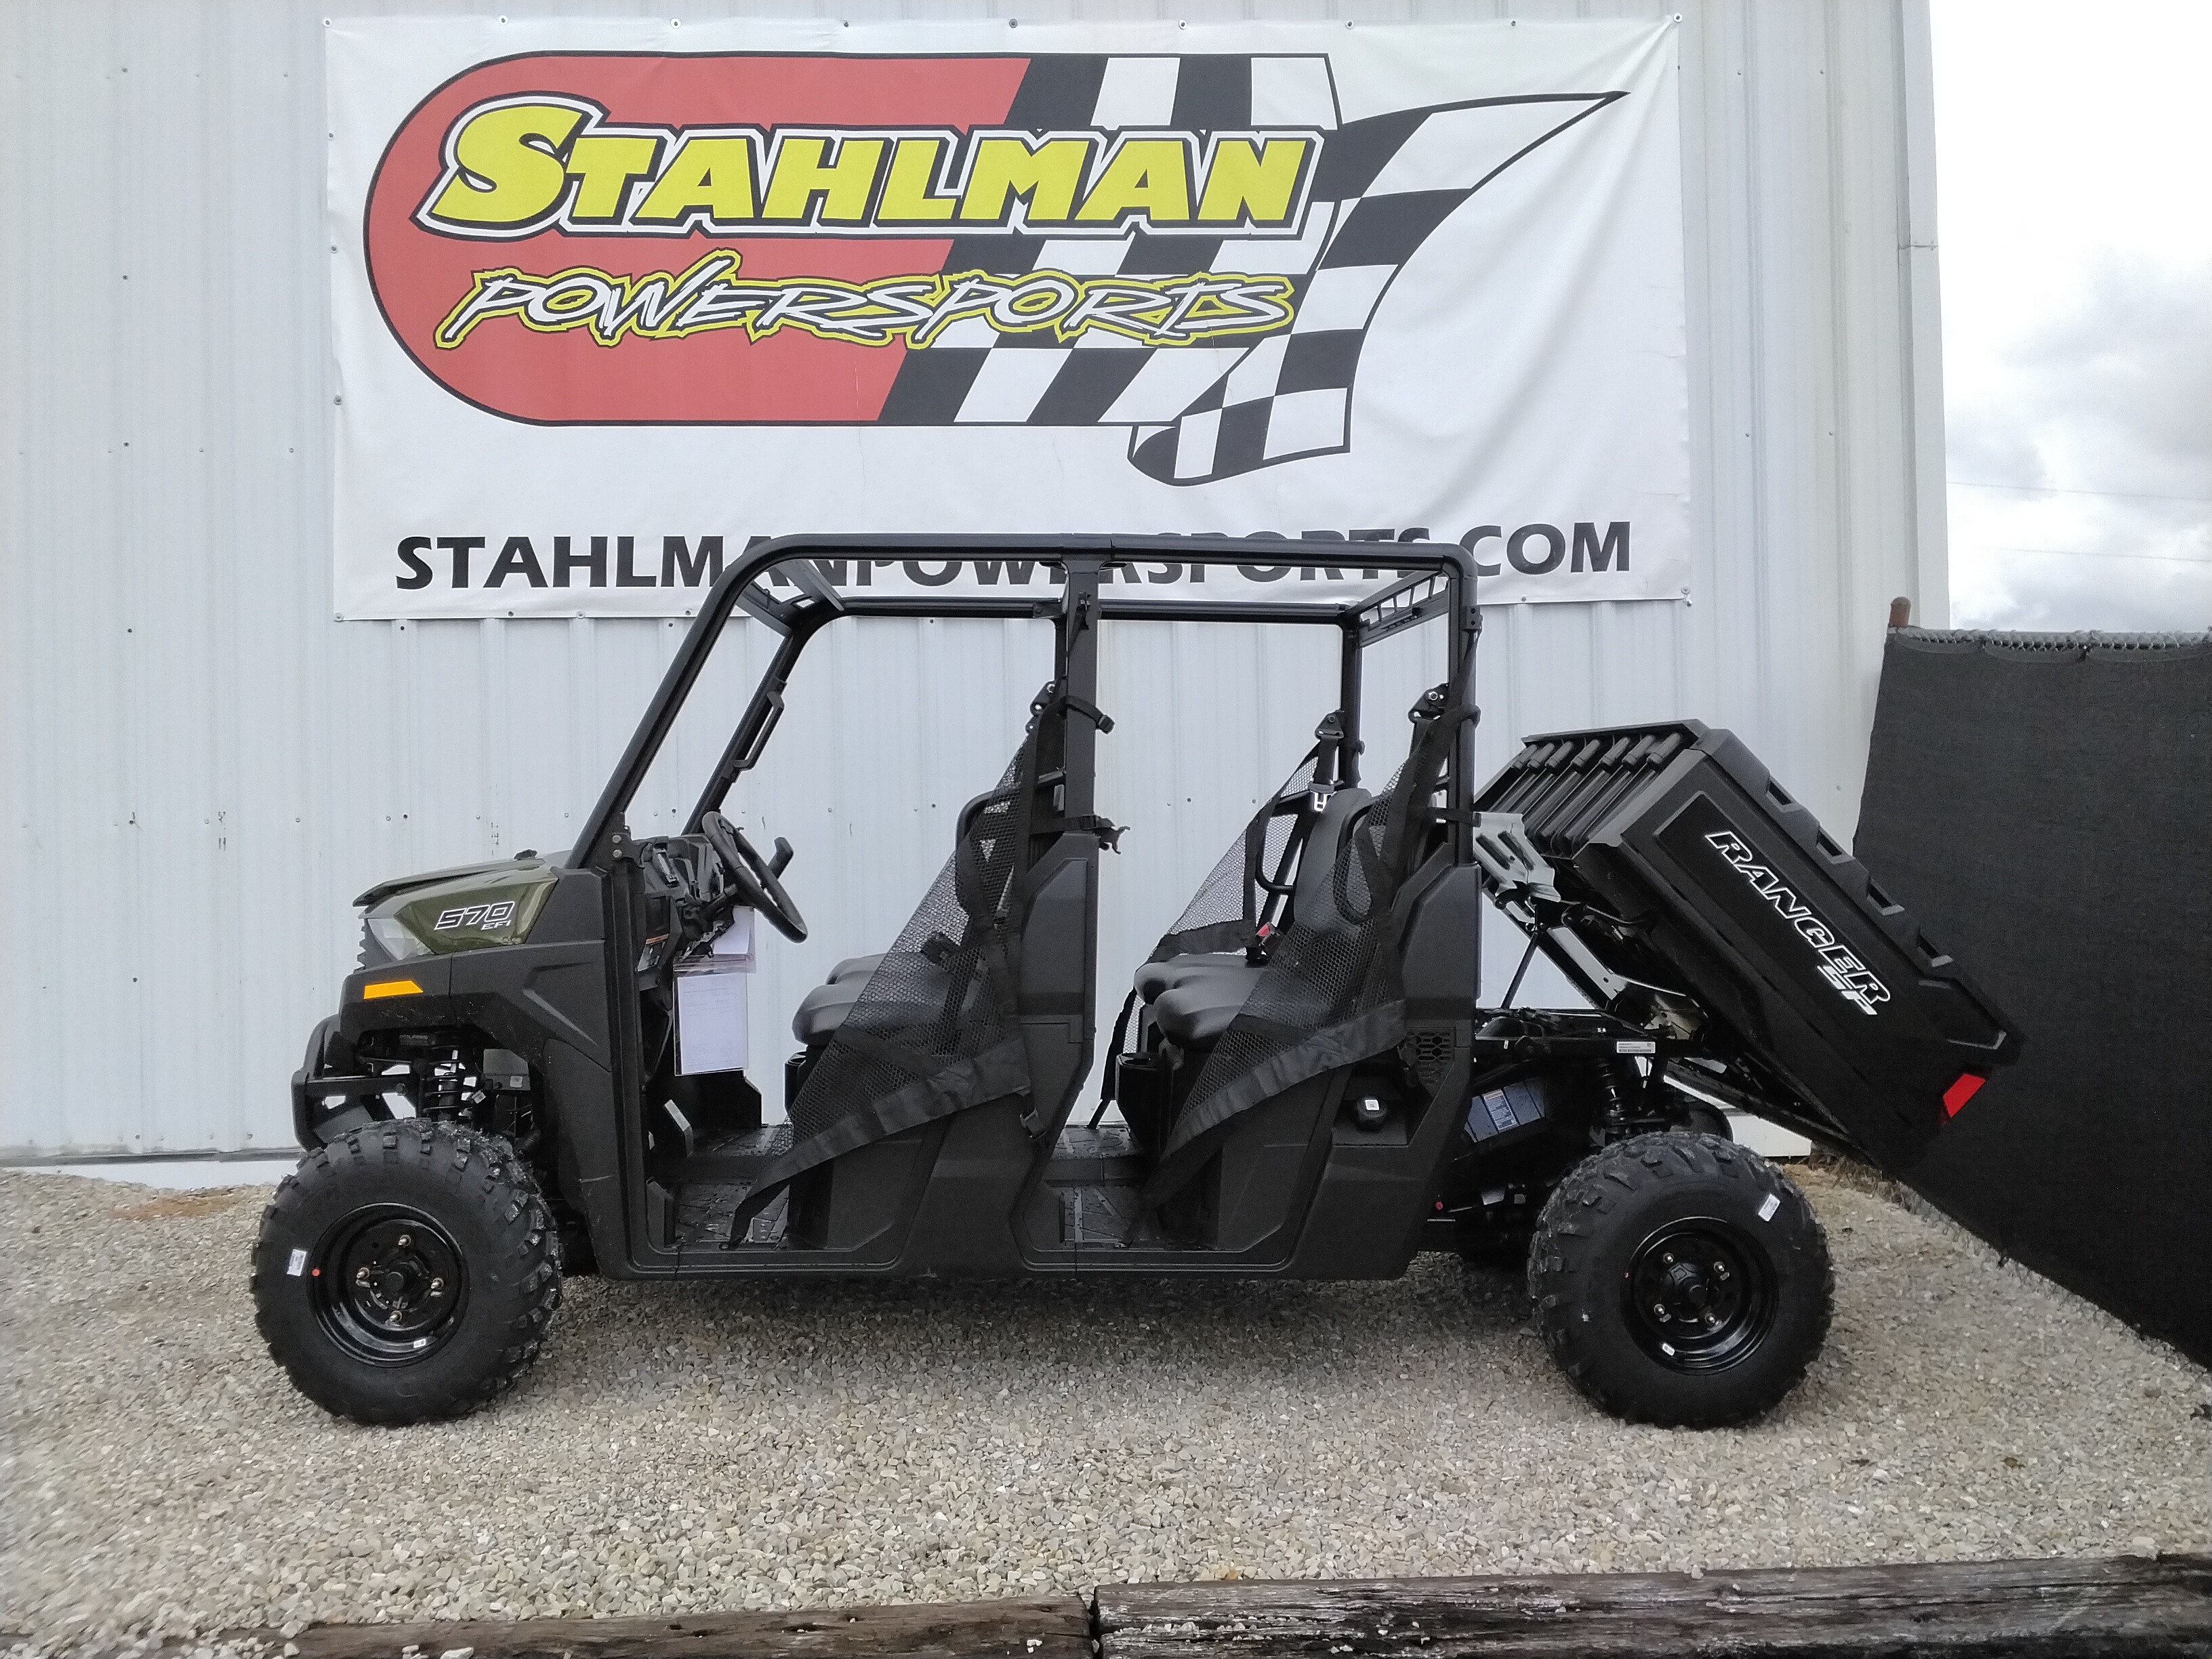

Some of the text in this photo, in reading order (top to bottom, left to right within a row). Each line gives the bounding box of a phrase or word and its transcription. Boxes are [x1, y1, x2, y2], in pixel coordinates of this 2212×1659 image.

[418, 97, 1316, 234] STAHLMAN
[438, 249, 1294, 347] POWERSPORTS
[434, 901, 515, 930] 570
[481, 920, 512, 930] EFI
[1704, 831, 1890, 1004] RANGER
[1818, 965, 1877, 1015] SP
